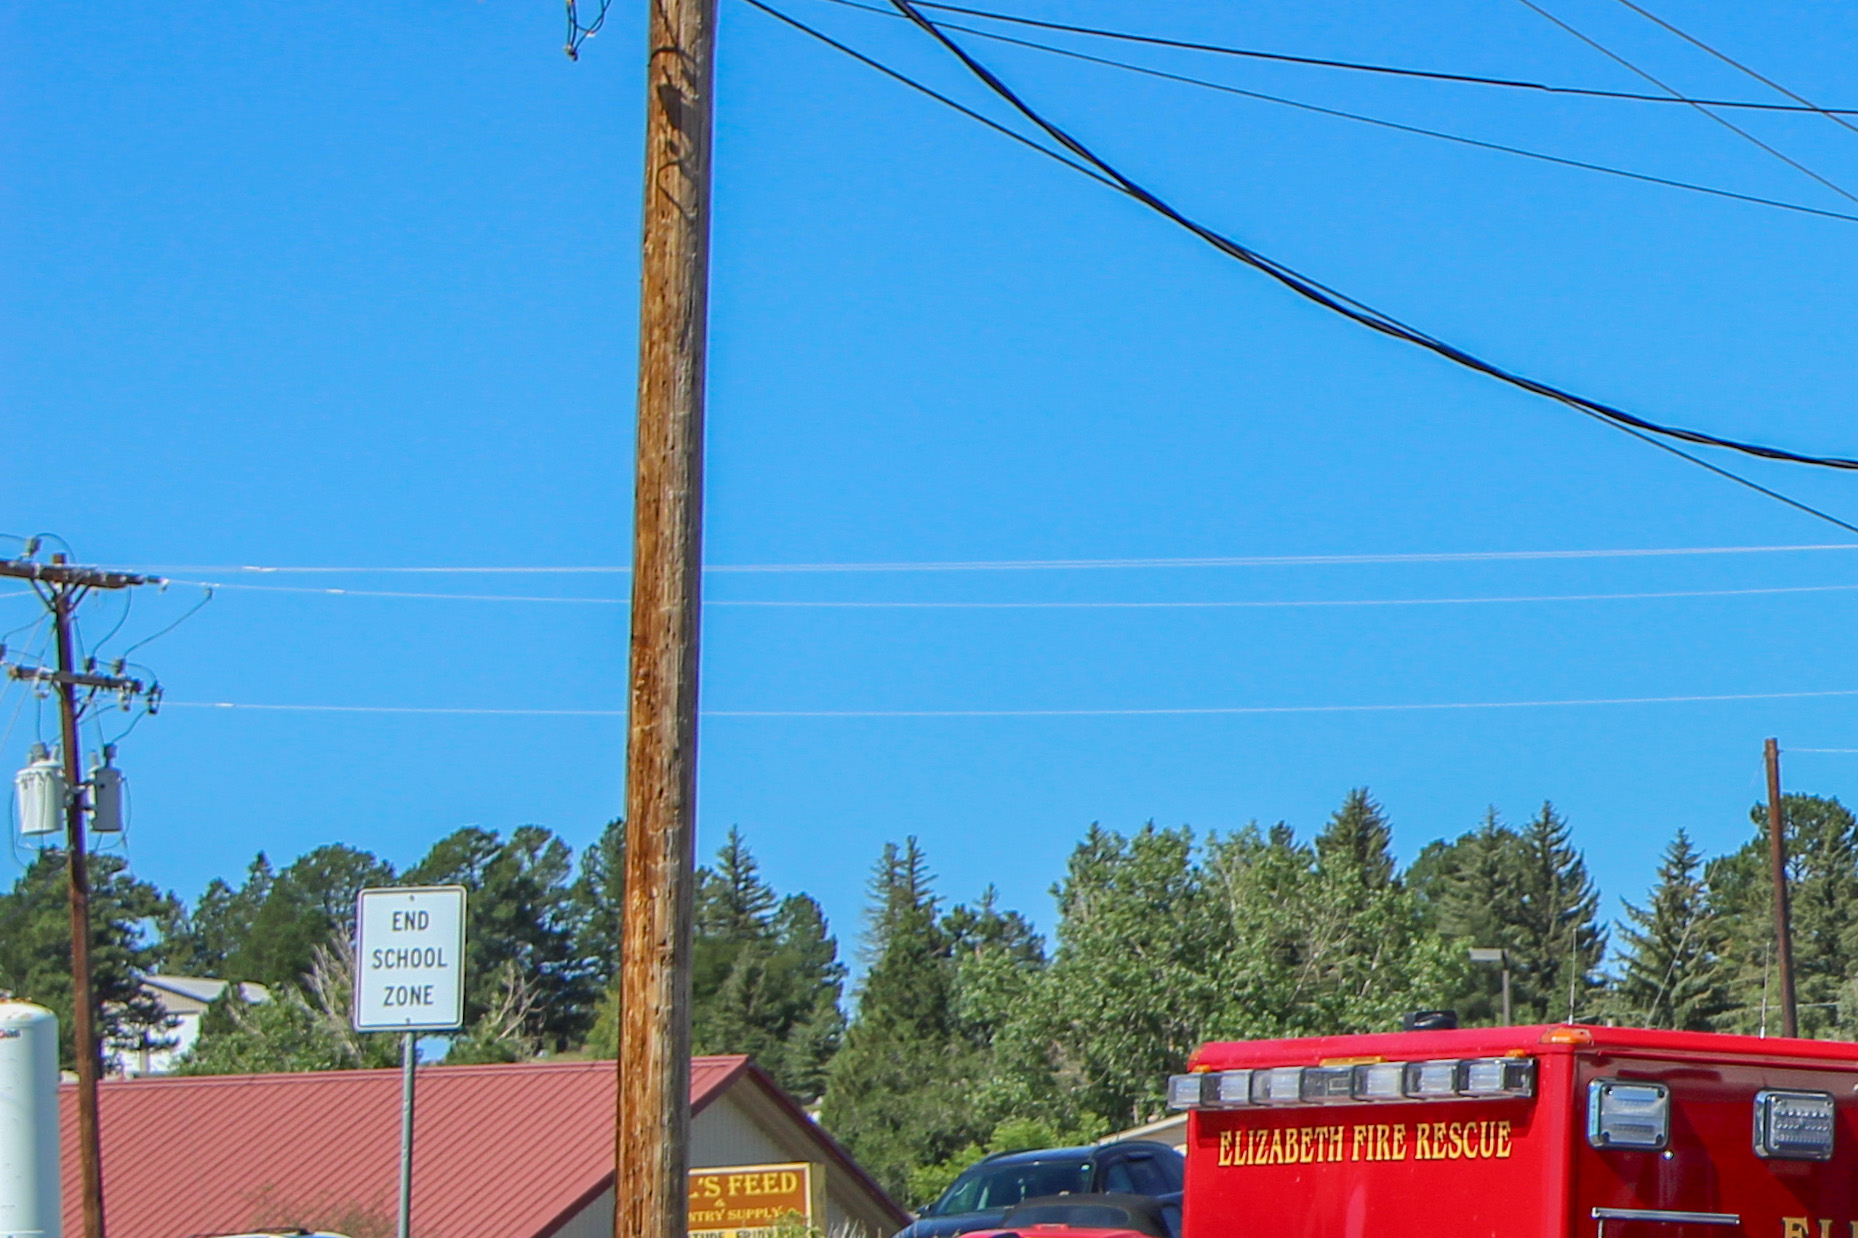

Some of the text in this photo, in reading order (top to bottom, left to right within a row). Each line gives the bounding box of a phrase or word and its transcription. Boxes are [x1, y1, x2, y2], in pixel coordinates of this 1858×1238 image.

[392, 910, 429, 932] END
[372, 947, 448, 970] SCHOOL
[383, 985, 434, 1007] ZONE
[1218, 1120, 1513, 1166] ELIZABETH FIRE RESCUE
[728, 1171, 798, 1197] FEED
[689, 1205, 783, 1222] NTRY SUPPLY
